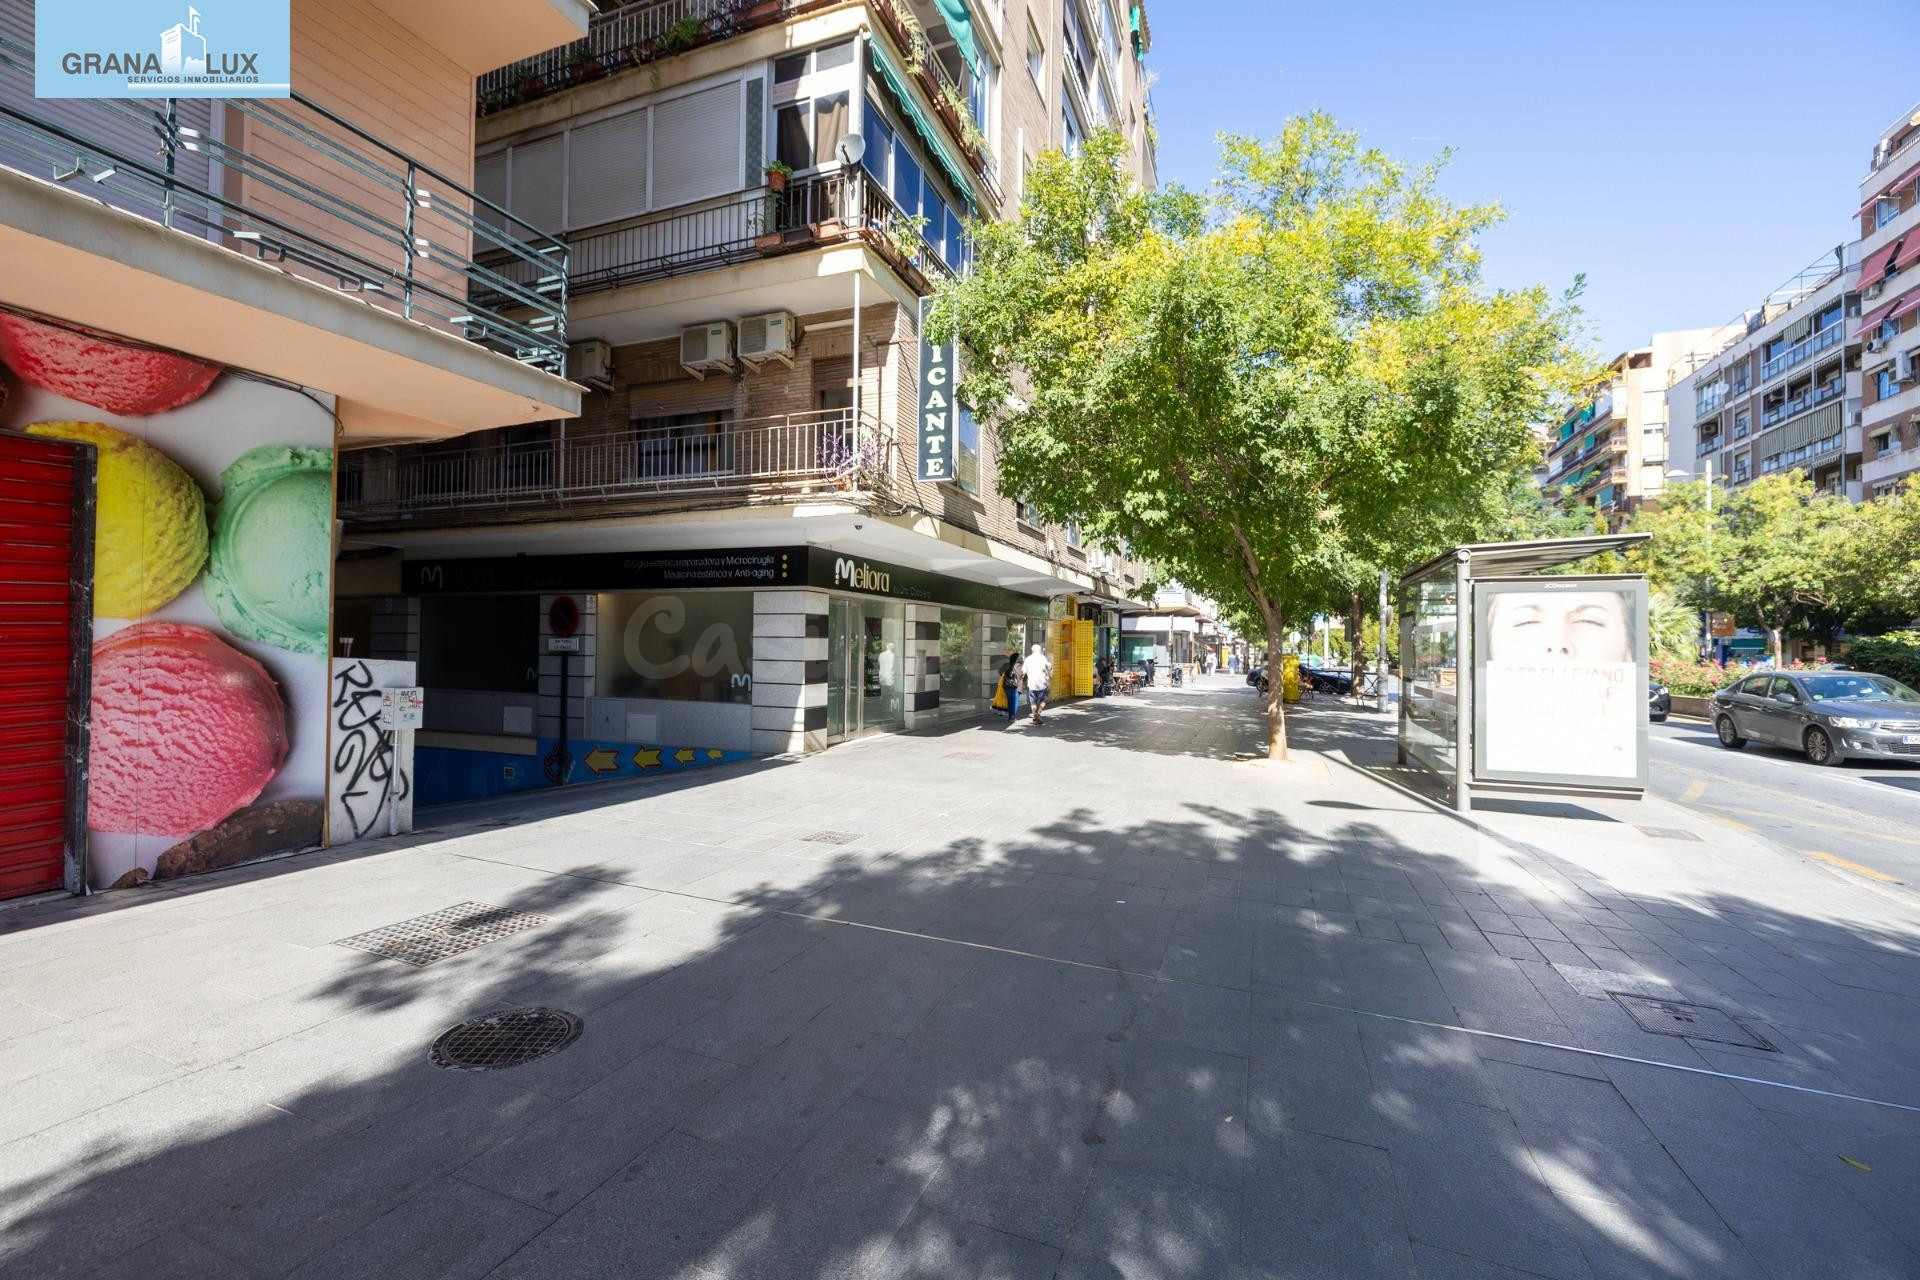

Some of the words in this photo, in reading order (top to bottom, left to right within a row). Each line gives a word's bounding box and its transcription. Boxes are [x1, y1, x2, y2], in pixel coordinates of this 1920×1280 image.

[924, 345, 948, 477] ICANTE
[734, 568, 774, 579] Anti-aging
[835, 557, 890, 592] Meliora
